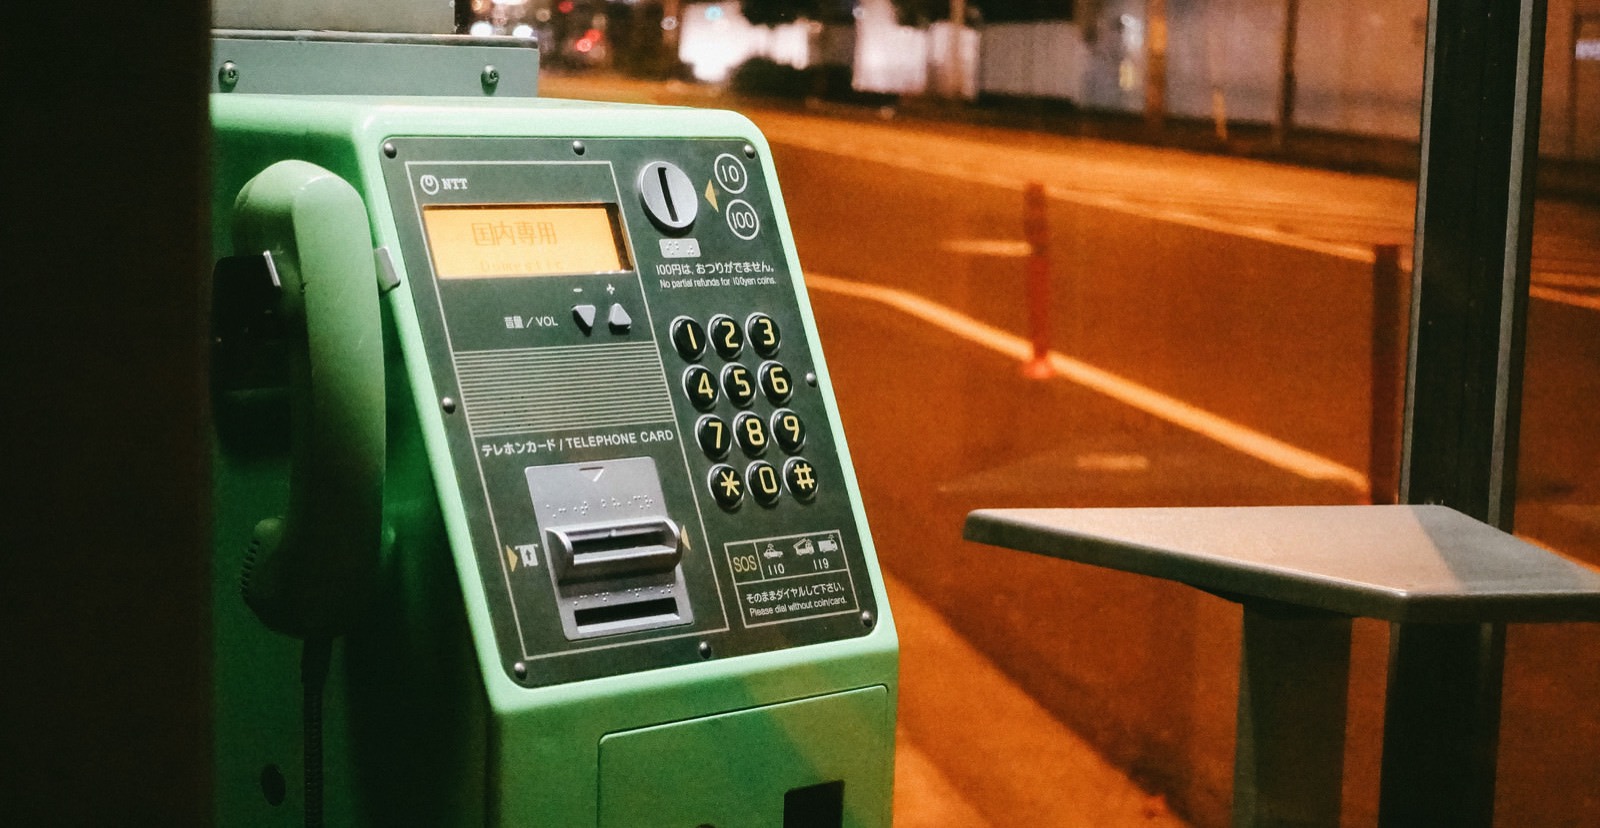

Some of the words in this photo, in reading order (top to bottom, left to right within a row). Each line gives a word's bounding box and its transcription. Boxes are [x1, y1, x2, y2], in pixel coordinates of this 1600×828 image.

[721, 165, 739, 182] 10
[441, 178, 468, 190] NTT
[731, 211, 755, 230] 100
[471, 220, 558, 246] 国内専用
[660, 279, 670, 289] No
[671, 278, 693, 289] partial
[694, 278, 720, 288] refunds
[721, 277, 731, 286] for
[757, 276, 776, 285] coins.
[687, 323, 698, 350] 1
[721, 321, 739, 348] 2
[758, 318, 775, 345] 3
[698, 372, 714, 399] 4
[733, 369, 751, 397] 5
[769, 366, 789, 394] 6
[708, 421, 722, 449] 7
[745, 418, 765, 446] 8
[783, 415, 800, 443] 9
[481, 439, 556, 457] テレホンカード
[565, 432, 637, 449] TELEPHONE
[640, 429, 674, 443] CARD
[758, 466, 778, 494] 0
[732, 555, 757, 573] SOS
[767, 563, 785, 576] 110
[812, 557, 830, 571] 119
[749, 607, 774, 618] Please
[775, 604, 788, 614] dial
[788, 600, 813, 612] without
